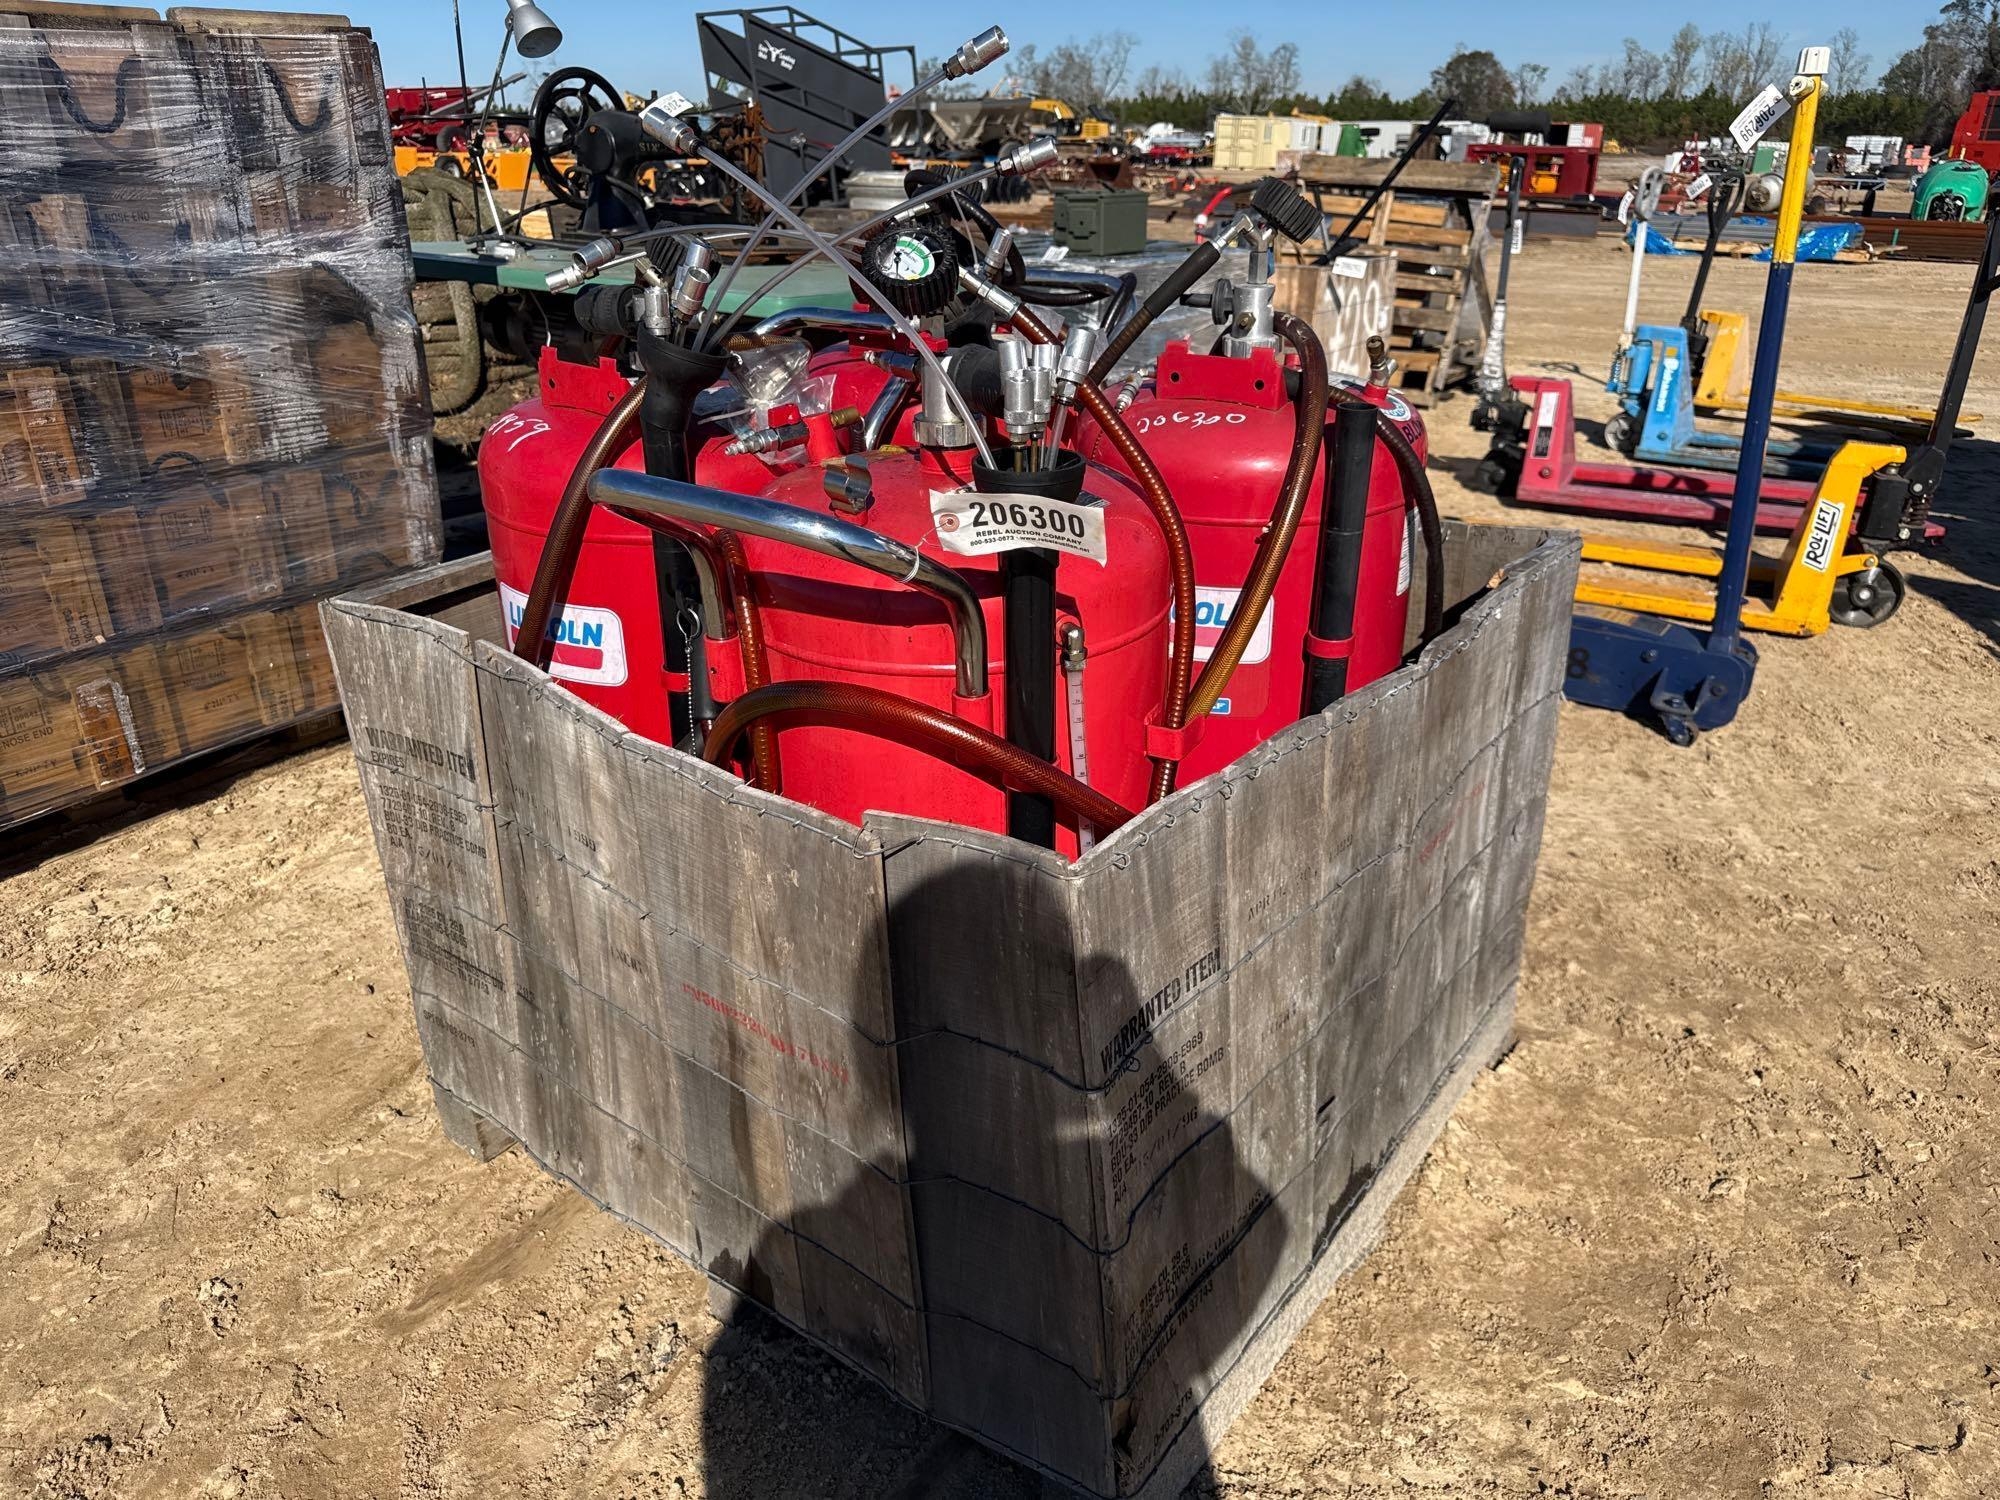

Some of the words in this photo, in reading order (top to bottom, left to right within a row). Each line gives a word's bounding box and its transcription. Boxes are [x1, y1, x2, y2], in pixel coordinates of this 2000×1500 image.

[1740, 104, 1776, 142] 206299
[968, 501, 1085, 538] 206300
[975, 529, 1002, 538] REBEL
[1004, 528, 1041, 537] AUCTION
[1042, 531, 1083, 546] COMPANY
[509, 600, 603, 648] LIOLN
[2, 732, 31, 750] NOSE
[32, 726, 54, 740] END
[371, 751, 406, 769] EXPIRES
[1100, 977, 1181, 1074] WARRANTED
[1185, 946, 1221, 993] ITEM
[1154, 1068, 1195, 1118] PRACTICE
[1197, 1047, 1225, 1077] BOMB
